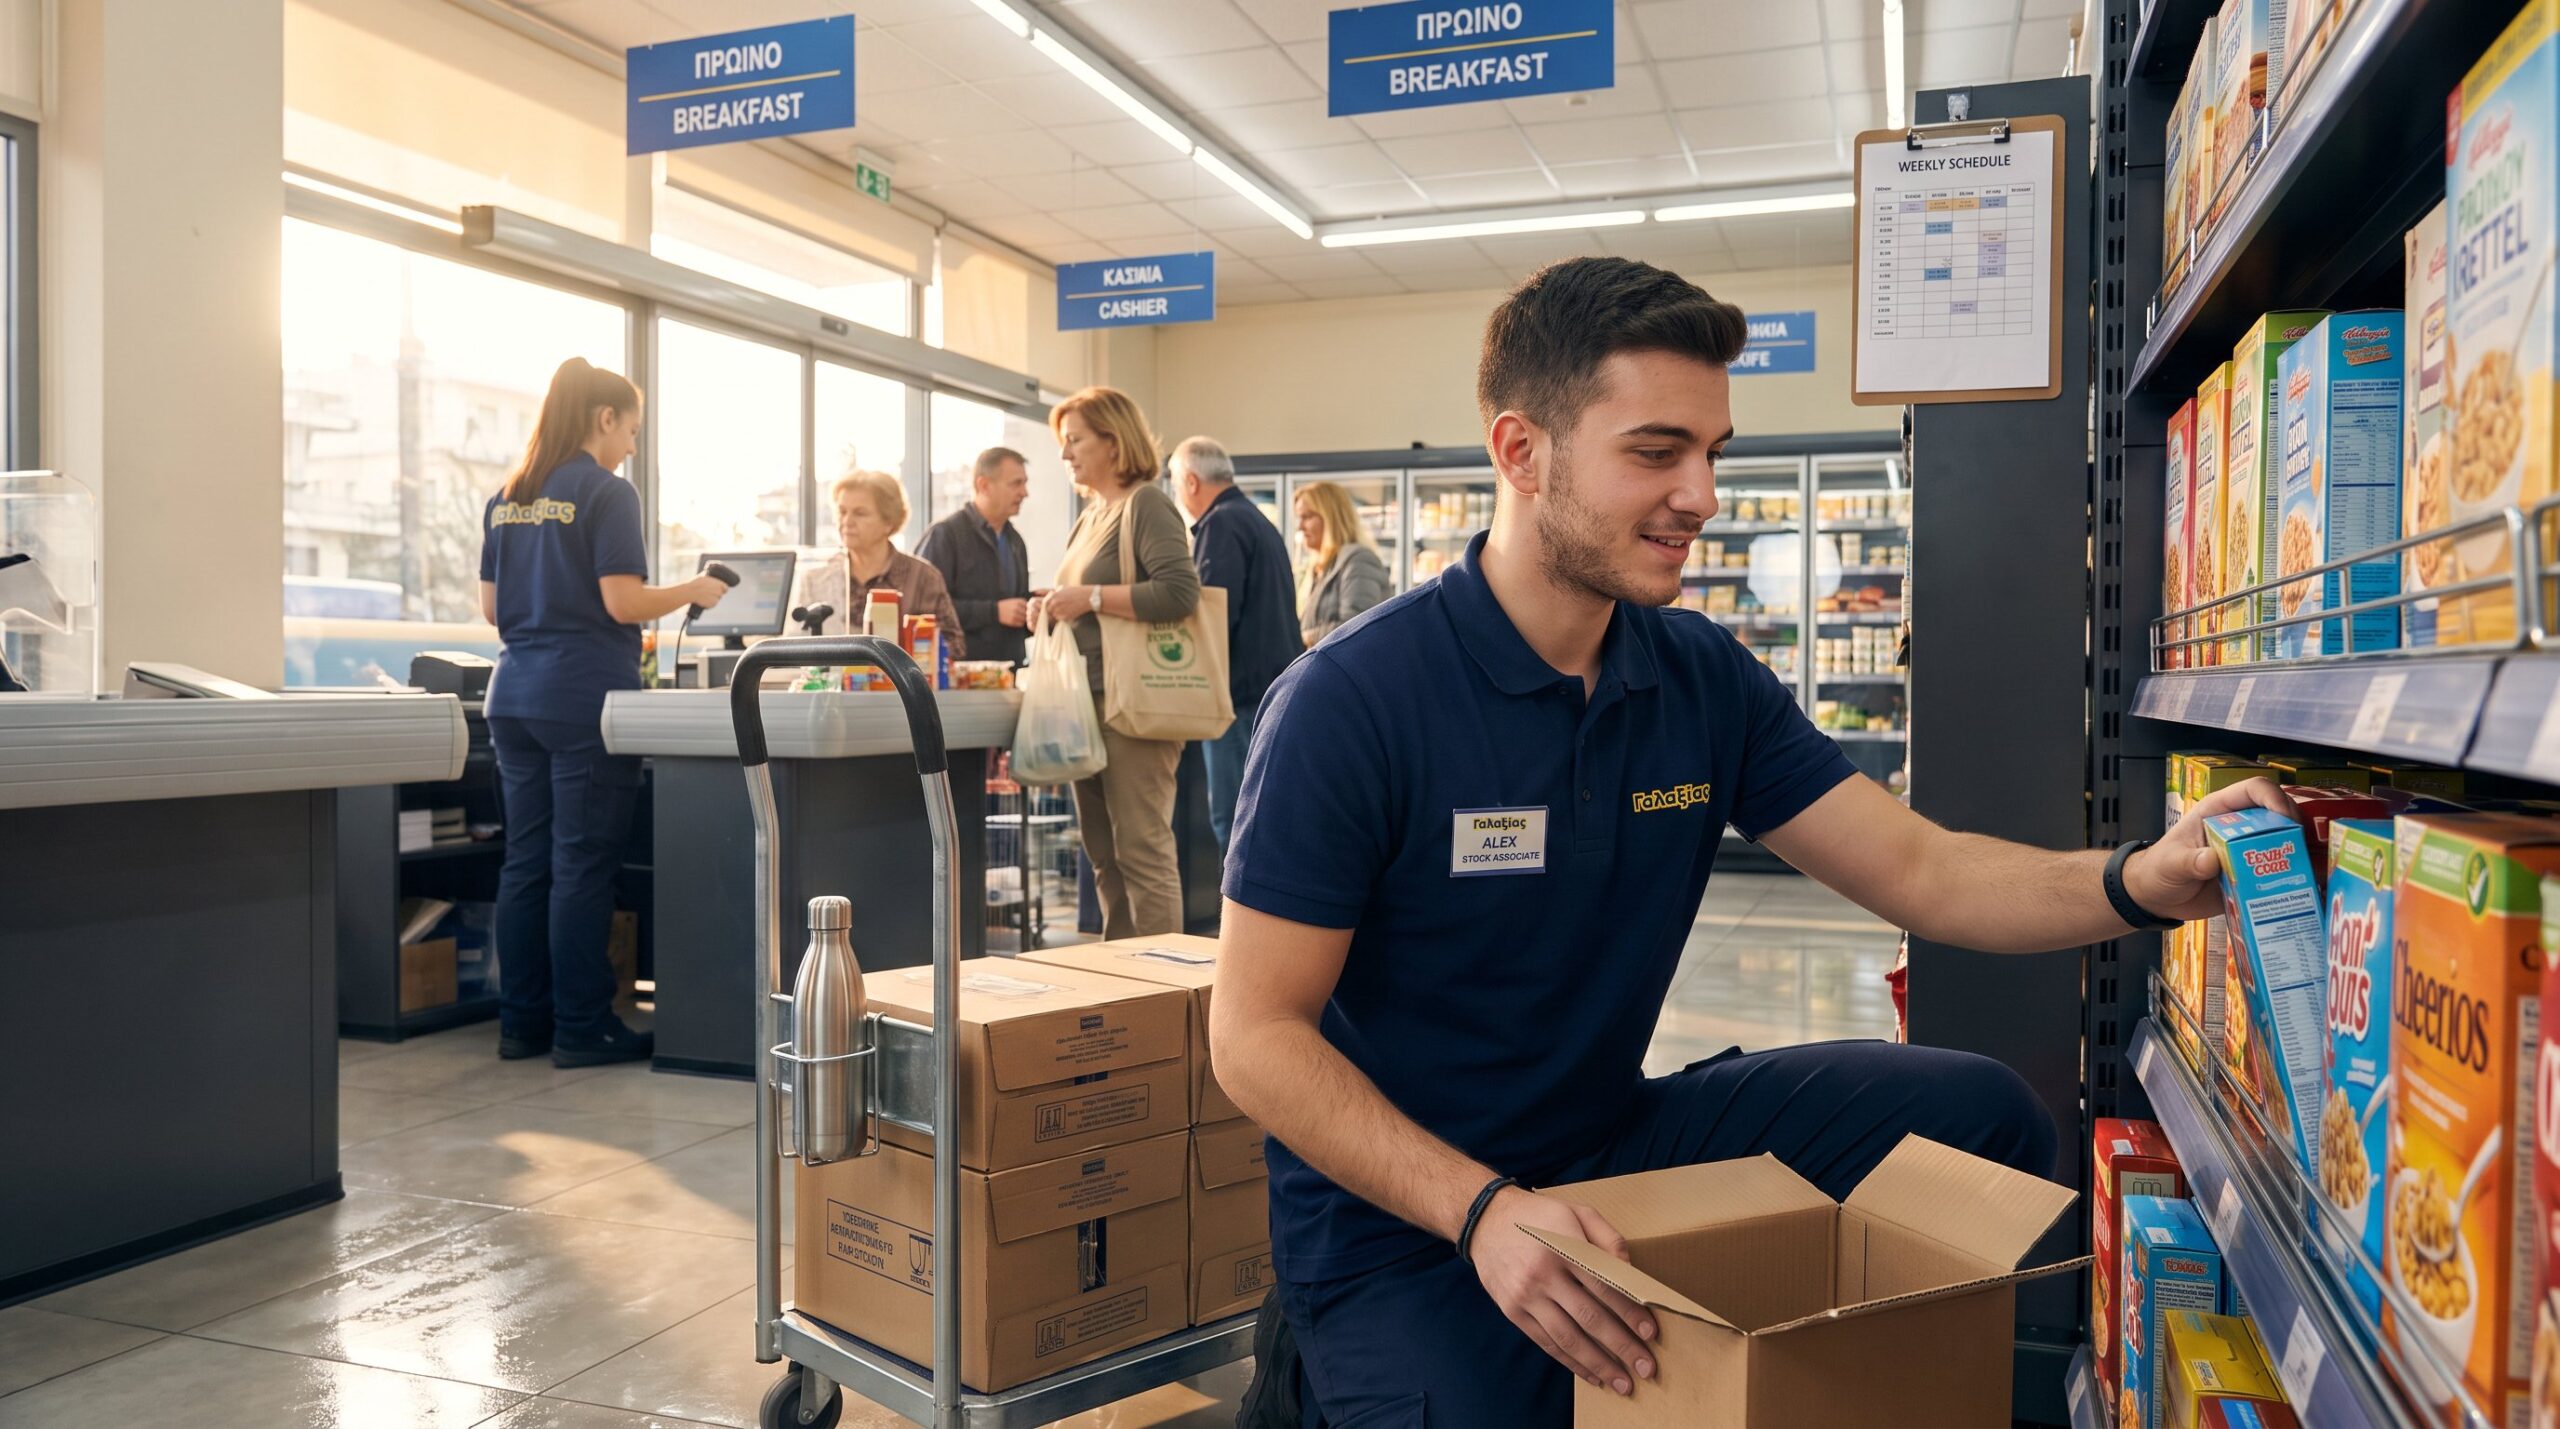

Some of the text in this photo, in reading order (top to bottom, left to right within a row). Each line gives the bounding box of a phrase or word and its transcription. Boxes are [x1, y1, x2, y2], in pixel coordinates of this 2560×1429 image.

[1416, 2, 1523, 41] ΠΡΩΙΝΟ
[694, 41, 783, 79] ΠΡΩΙΝΟ
[1389, 52, 1549, 96] BREAKFAST
[673, 92, 804, 135] BREAKFAST
[1898, 154, 2012, 173] WEEKLY SCHEDULE
[1098, 297, 1168, 320] CASHIER
[1632, 783, 1711, 813] Γαλαξίας
[1472, 817, 1527, 831] Γαλαξίας
[1462, 851, 1541, 864] STOCK ASSOCIATE
[1481, 835, 1518, 850] ALEX
[2393, 938, 2490, 1074] Cheerios
